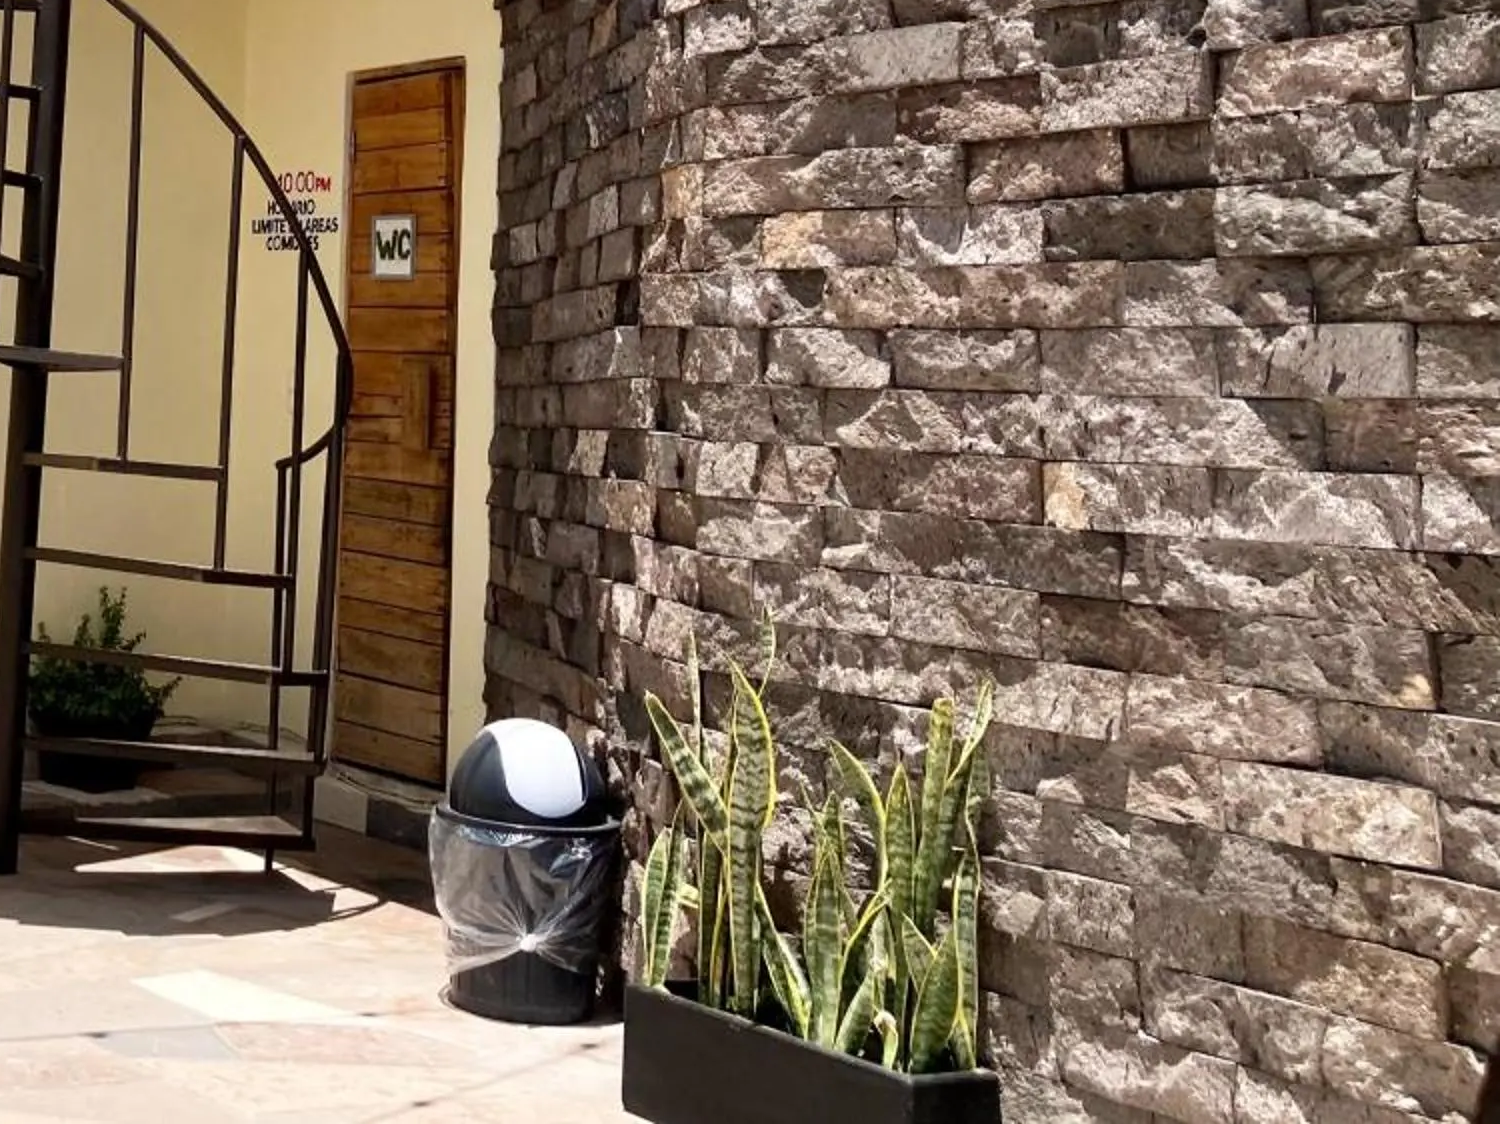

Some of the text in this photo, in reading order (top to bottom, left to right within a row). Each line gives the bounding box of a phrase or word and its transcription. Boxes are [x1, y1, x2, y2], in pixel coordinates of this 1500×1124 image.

[251, 218, 287, 234] LIMITE
[304, 217, 339, 233] AREAS
[376, 228, 411, 261] WC
